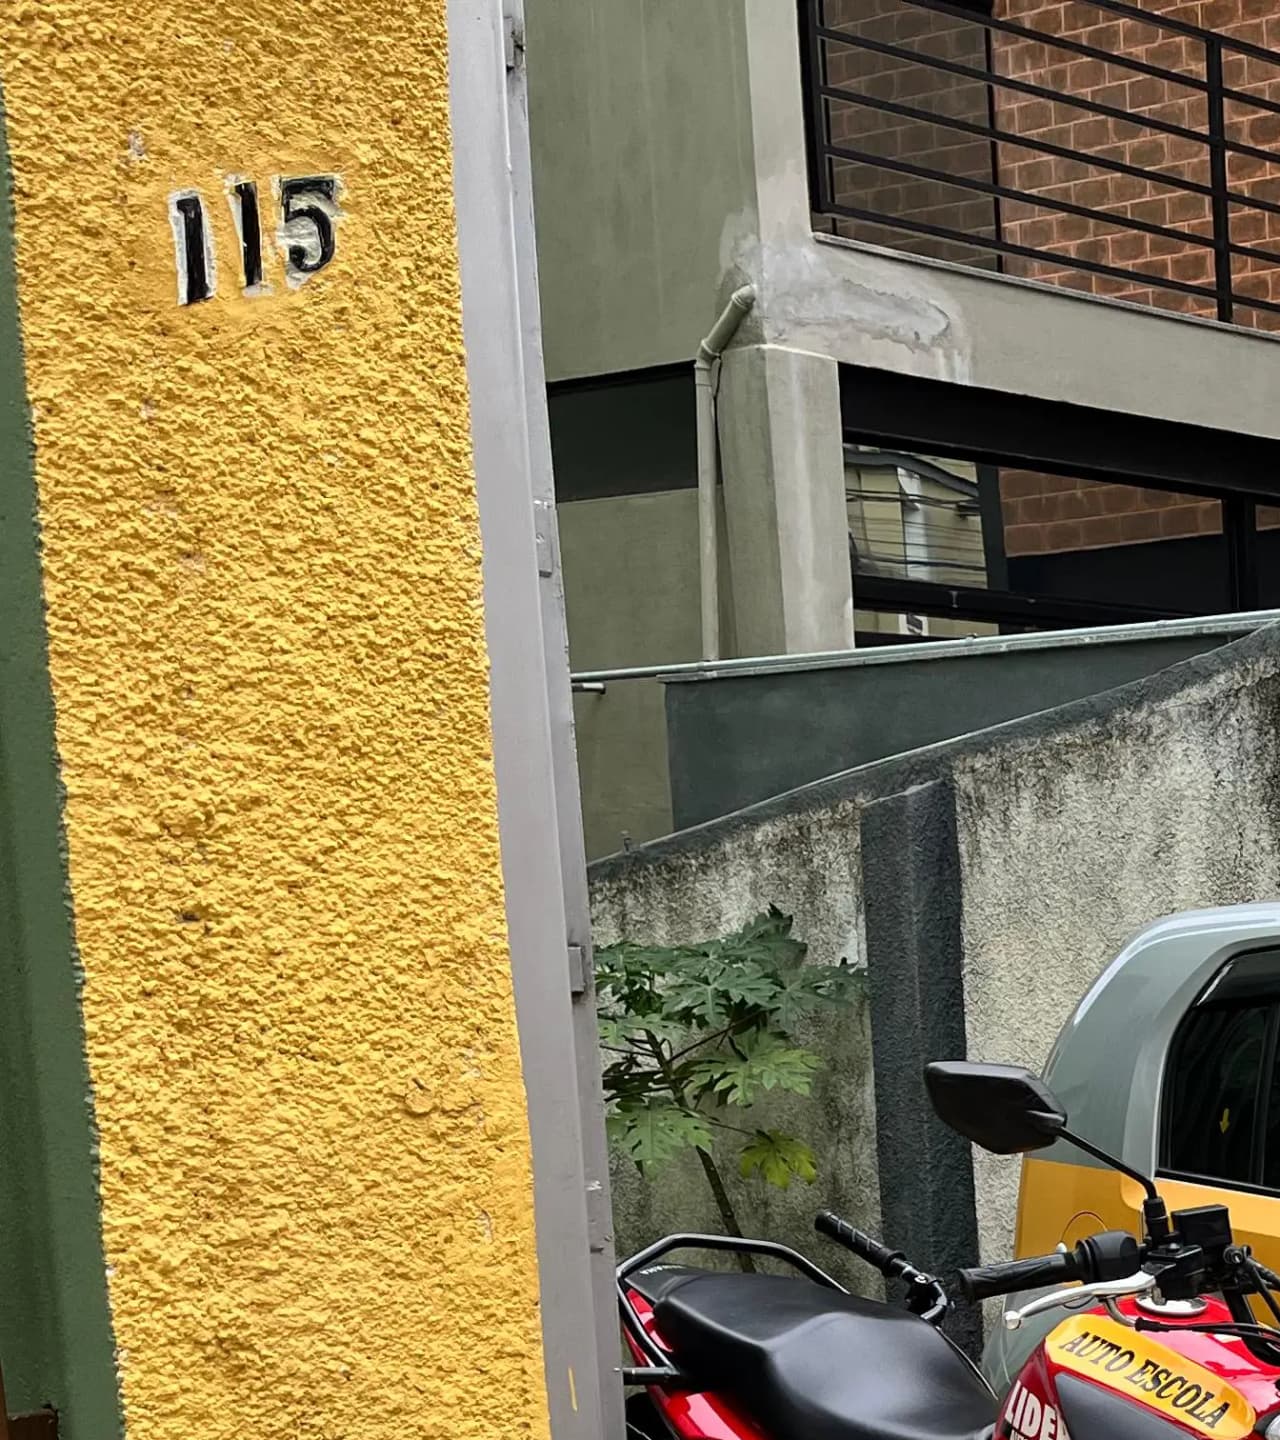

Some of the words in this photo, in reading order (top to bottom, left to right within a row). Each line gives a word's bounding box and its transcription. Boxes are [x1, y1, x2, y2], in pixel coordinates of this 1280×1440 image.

[174, 176, 337, 306] 115
[1058, 1331, 1135, 1372] AUTO
[1125, 1358, 1231, 1429] ESCOLA
